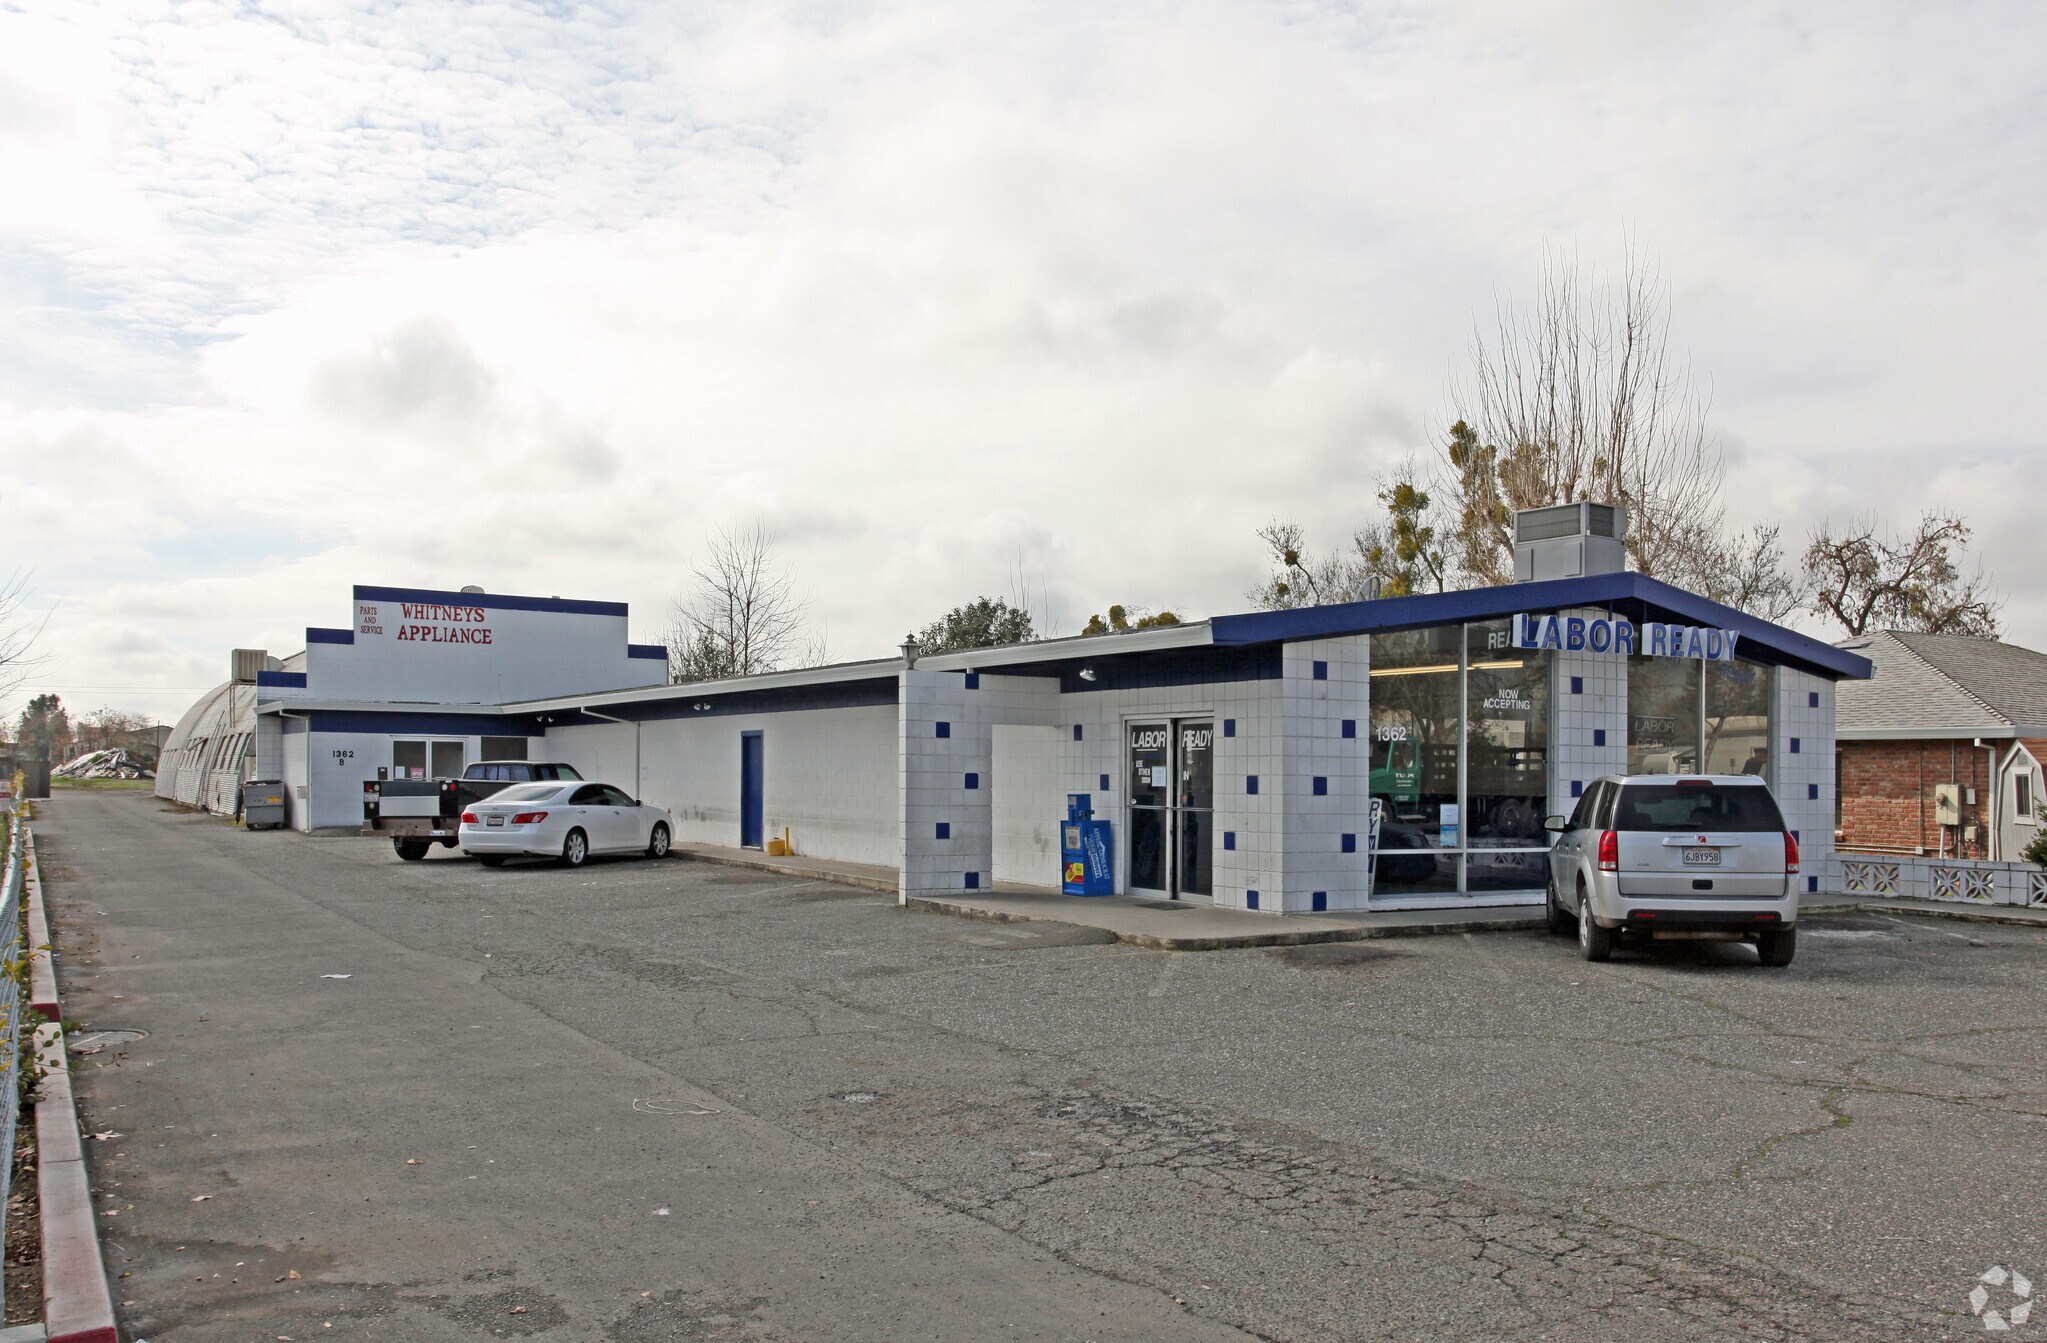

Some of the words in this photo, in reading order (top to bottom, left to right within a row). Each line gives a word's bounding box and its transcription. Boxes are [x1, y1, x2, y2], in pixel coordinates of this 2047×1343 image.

[360, 606, 377, 615] PARTS
[401, 603, 485, 622] WHITNEYS
[363, 616, 377, 624] AND
[360, 625, 383, 635] SERVICE
[397, 624, 492, 645] APPLIANCE
[1488, 630, 1511, 650] REA
[1513, 613, 1633, 655] LABOR
[1642, 622, 1740, 661] READY
[1499, 689, 1519, 700] NOW
[1483, 699, 1530, 710] ACCEPTING
[1634, 720, 1675, 733] LABOR
[1131, 731, 1167, 748] LABOR
[1182, 730, 1213, 747] READY
[1376, 726, 1407, 742] 1362
[333, 750, 354, 758] 1362
[1685, 852, 1719, 861] 6JBY958
